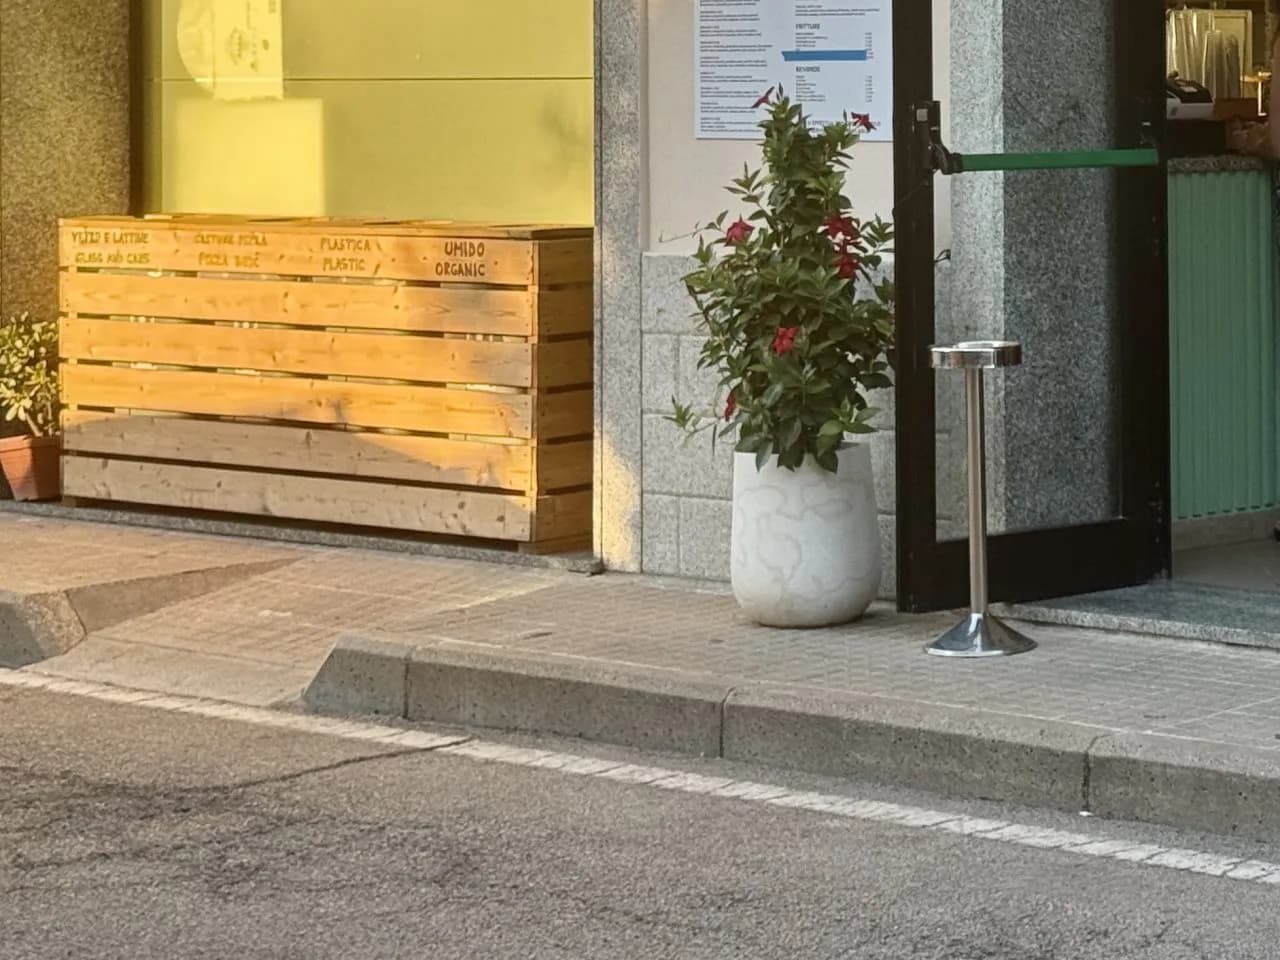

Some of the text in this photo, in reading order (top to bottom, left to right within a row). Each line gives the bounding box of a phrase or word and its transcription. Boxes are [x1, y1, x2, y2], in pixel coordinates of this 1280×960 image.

[320, 237, 371, 252] PLASTICA
[444, 241, 485, 258] UMIDO
[322, 257, 366, 273] PLASTIC
[435, 261, 486, 278] ORGANIC
